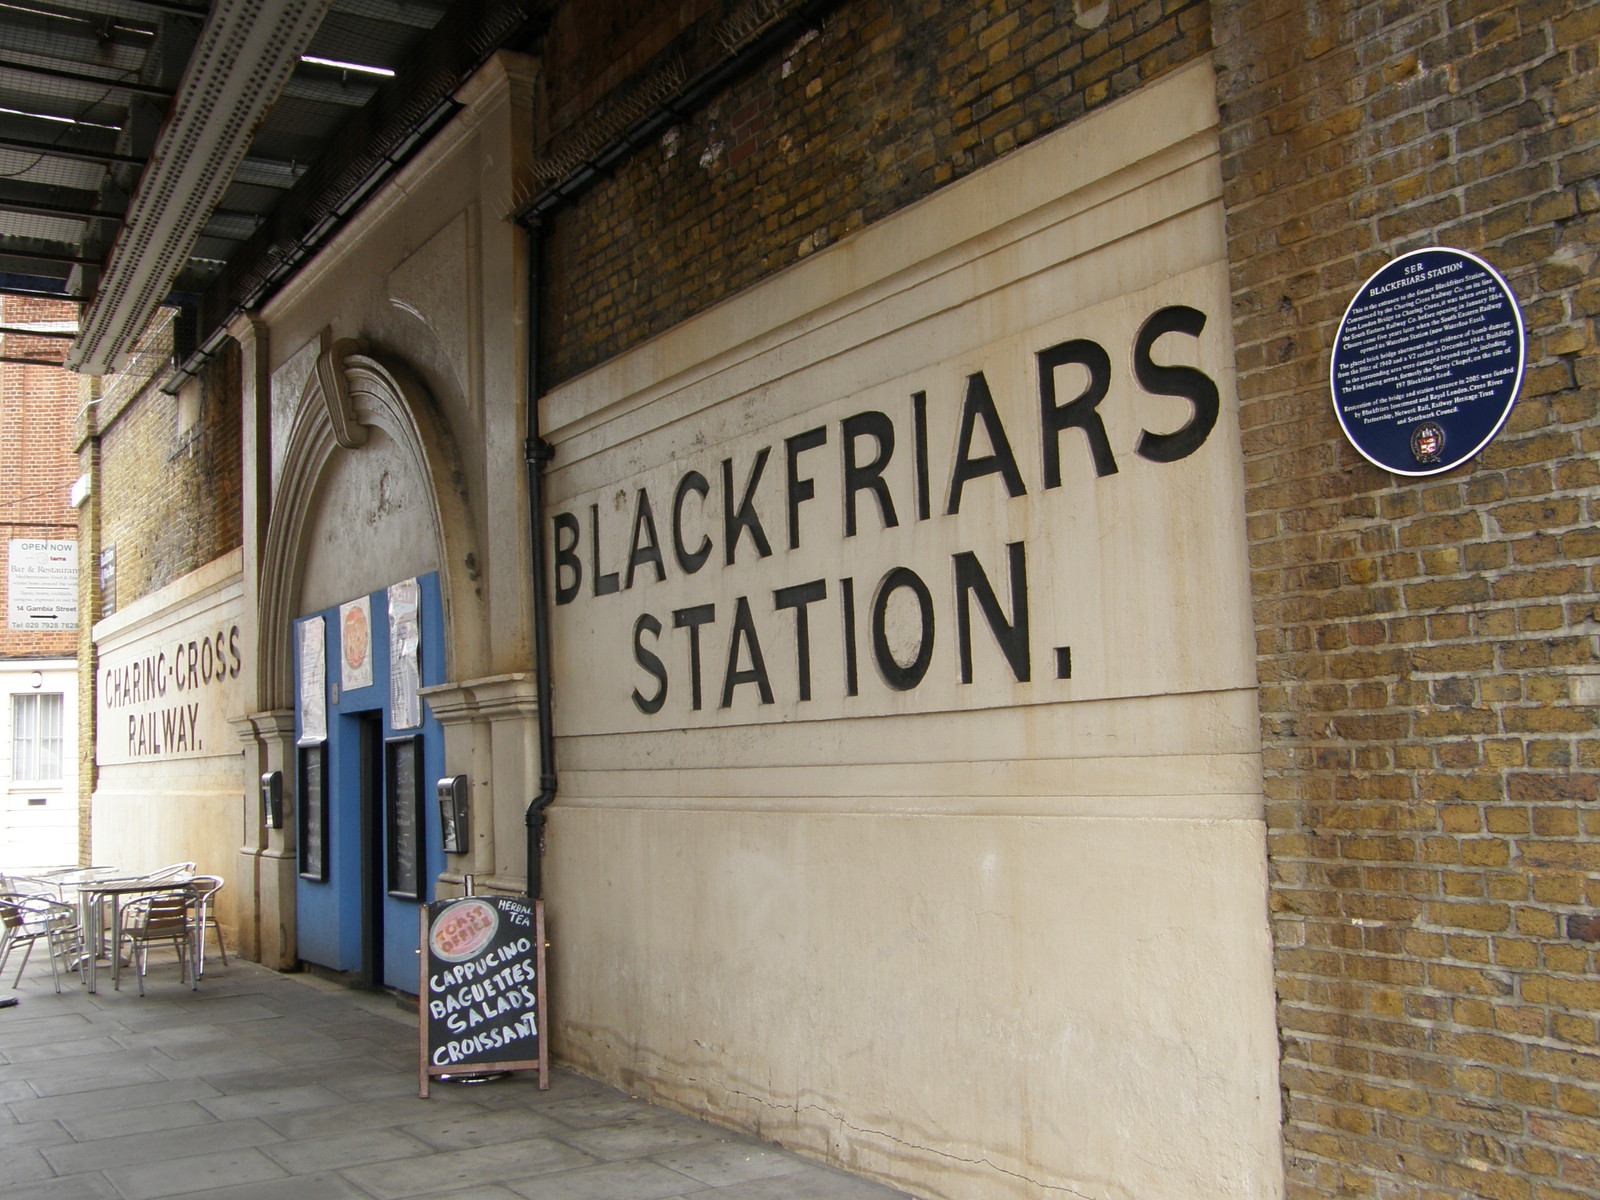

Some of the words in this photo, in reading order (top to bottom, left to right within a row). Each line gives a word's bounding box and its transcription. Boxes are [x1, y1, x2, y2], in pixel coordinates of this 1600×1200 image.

[1370, 273, 1425, 296] BLACKFRIARS
[1428, 262, 1463, 279] STATION
[1405, 263, 1423, 275] SER
[1347, 312, 1376, 324] Commenced
[1394, 301, 1414, 312] Charing
[1415, 296, 1430, 304] Cross
[1431, 290, 1452, 302] Railway
[1358, 320, 1376, 329] London
[1378, 315, 1393, 325] Bridge
[1402, 307, 1423, 318] Charing
[1459, 292, 1474, 301] taken
[1378, 297, 1399, 307] entrance
[1417, 286, 1434, 296] former
[1436, 278, 1464, 290] Blackfriars
[1344, 340, 1362, 350] Closure
[1441, 314, 1456, 323] South
[1458, 308, 1478, 318] Eastern
[1480, 302, 1502, 314] Railway
[1351, 331, 1365, 339] South
[1367, 326, 1385, 335] Eastern
[1386, 320, 1406, 331] Railway
[1418, 312, 1434, 321] before
[1436, 305, 1457, 318] opening
[1466, 297, 1487, 309] January
[1350, 359, 1366, 368] glazed
[1381, 351, 1396, 360] bridge
[1440, 333, 1463, 343] evidence
[1472, 327, 1487, 335] bomb
[1489, 321, 1510, 332] damage
[1360, 345, 1378, 355] opened
[1386, 336, 1409, 346] Waterloo
[1410, 331, 1428, 340] Station
[1444, 320, 1468, 331] Waterloo
[1418, 349, 1434, 357] rocket
[1442, 340, 1468, 351] December
[1486, 328, 1514, 342] Buildings
[1353, 384, 1364, 392] Ring
[1366, 379, 1382, 389] boxing
[1400, 369, 1422, 380] formerly
[1433, 362, 1450, 372] Surrey
[1361, 369, 1390, 382] surrounding
[1417, 357, 1439, 368] damaged
[1441, 351, 1460, 362] beyond
[1480, 340, 1506, 352] including
[1344, 401, 1371, 412] Restoration
[1389, 393, 1404, 403] bridge
[1417, 386, 1434, 395] station
[1436, 381, 1457, 390] entrance
[1494, 367, 1514, 376] funded
[1362, 406, 1389, 416] Blackfriars
[1390, 399, 1418, 409] Investment
[1430, 392, 1445, 402] Royal
[1487, 378, 1503, 386] River
[1407, 375, 1435, 386] Blackfriars
[1395, 408, 1416, 417] Network
[1432, 399, 1452, 410] Railway
[1454, 393, 1478, 405] Heritage
[1408, 412, 1434, 422] Southwark
[553, 304, 1221, 607] BLACKFRIARS
[22, 543, 48, 551] OPEN
[631, 542, 1071, 716] STATION.
[128, 702, 202, 757] RAILWAY.
[436, 905, 484, 941] TOAST
[498, 900, 533, 915] HERBAL
[509, 912, 530, 926] TEA
[430, 938, 530, 992] CAPPUCINO
[430, 958, 536, 1020] BAGUETTES
[433, 1012, 538, 1066] CROISSANT
